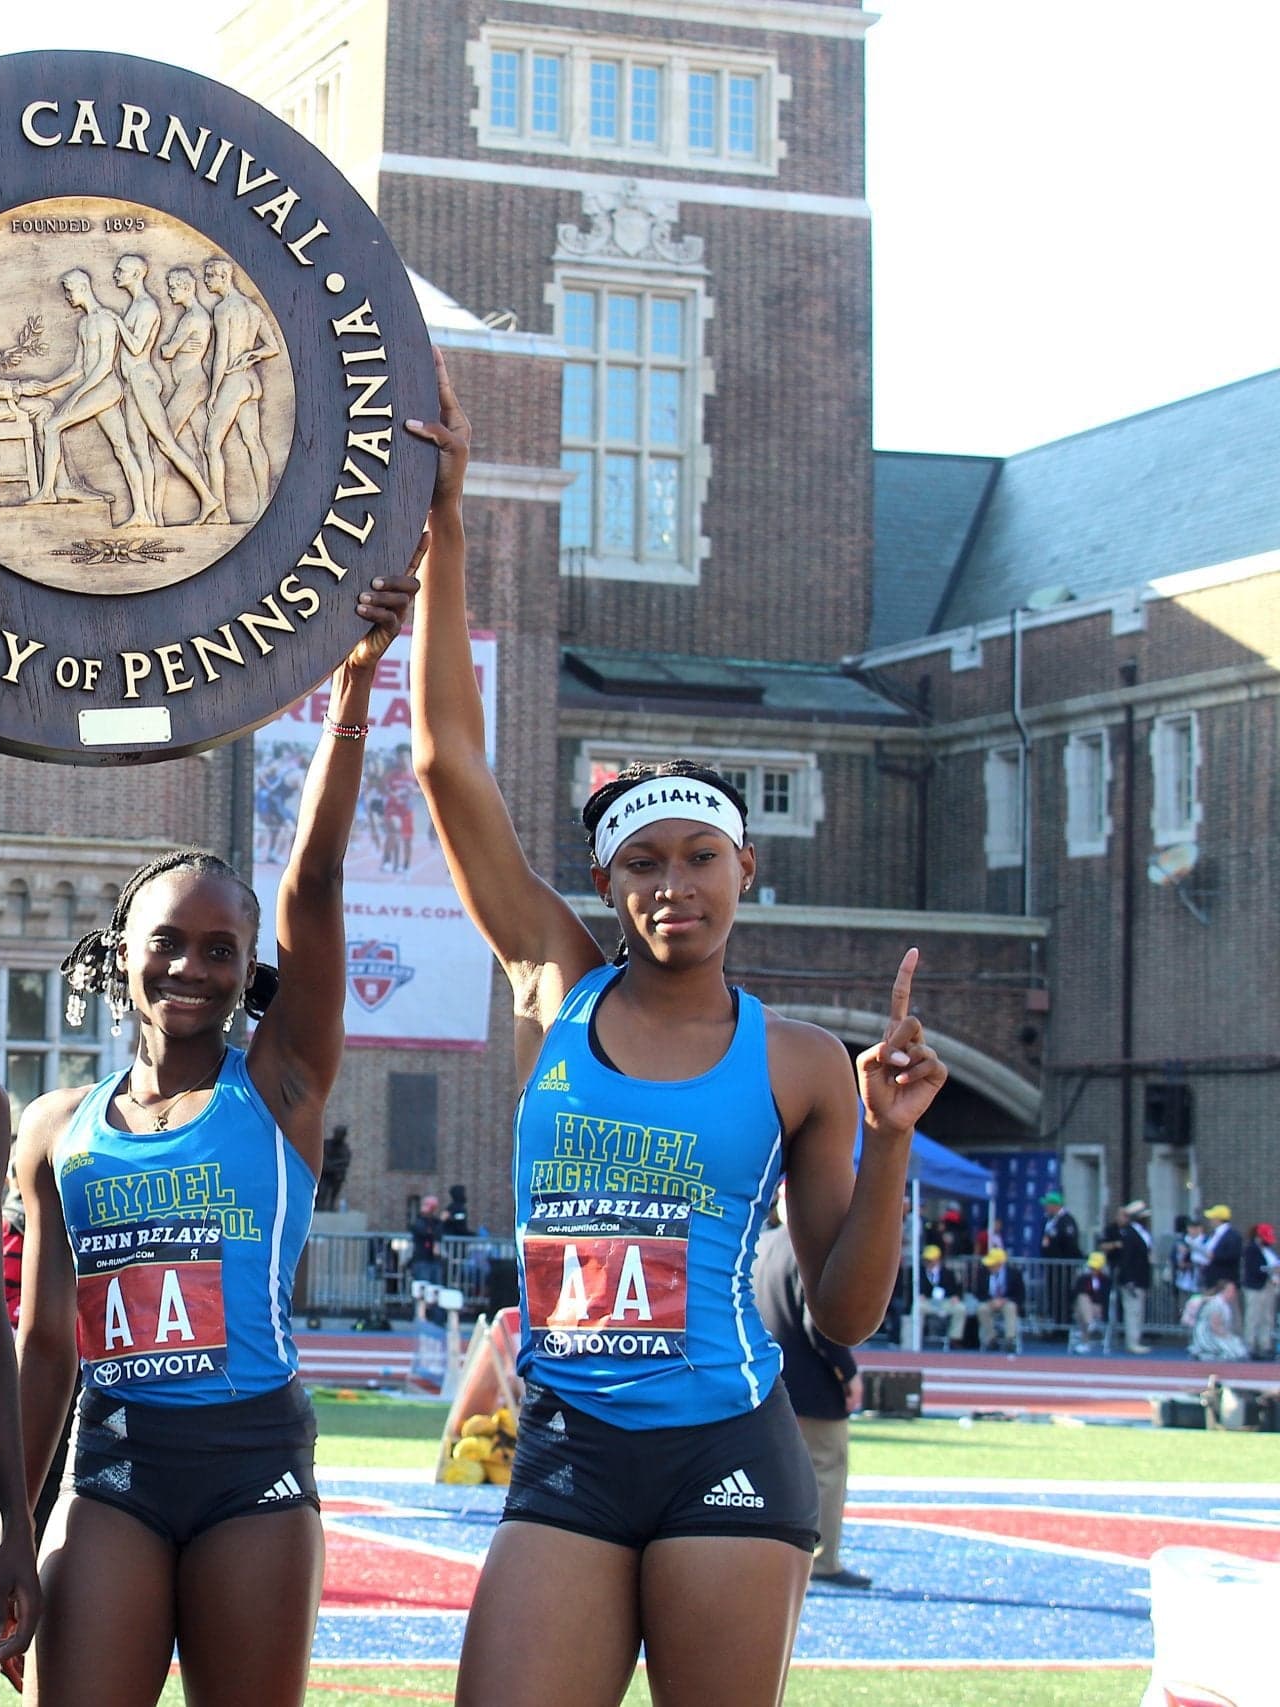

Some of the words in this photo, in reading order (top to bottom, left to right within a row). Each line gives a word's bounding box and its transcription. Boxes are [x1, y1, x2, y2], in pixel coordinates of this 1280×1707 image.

[21, 99, 331, 267] CARNIVAL
[11, 218, 91, 233] FOUNDED
[104, 217, 146, 232] 1895
[56, 655, 103, 692] OF
[123, 298, 393, 699] PENNSYLVANIA
[623, 788, 701, 818] ALLIAH
[537, 1079, 570, 1092] adidas
[554, 1112, 705, 1180] HYDEL
[62, 1156, 95, 1179] adidas
[86, 1162, 236, 1225] HYDEL
[530, 1160, 601, 1194] HIGH
[605, 1166, 725, 1218] SCHOOL
[531, 1198, 590, 1219] PENN
[594, 1198, 693, 1220] RELAYS
[78, 1231, 133, 1254] PENN
[136, 1226, 221, 1247] RELAYS
[546, 1222, 620, 1234] ON-RUNNING.COM
[573, 1334, 670, 1356] TOYOTA
[123, 1353, 215, 1380] TOYOTA
[703, 1491, 765, 1508] adidas
